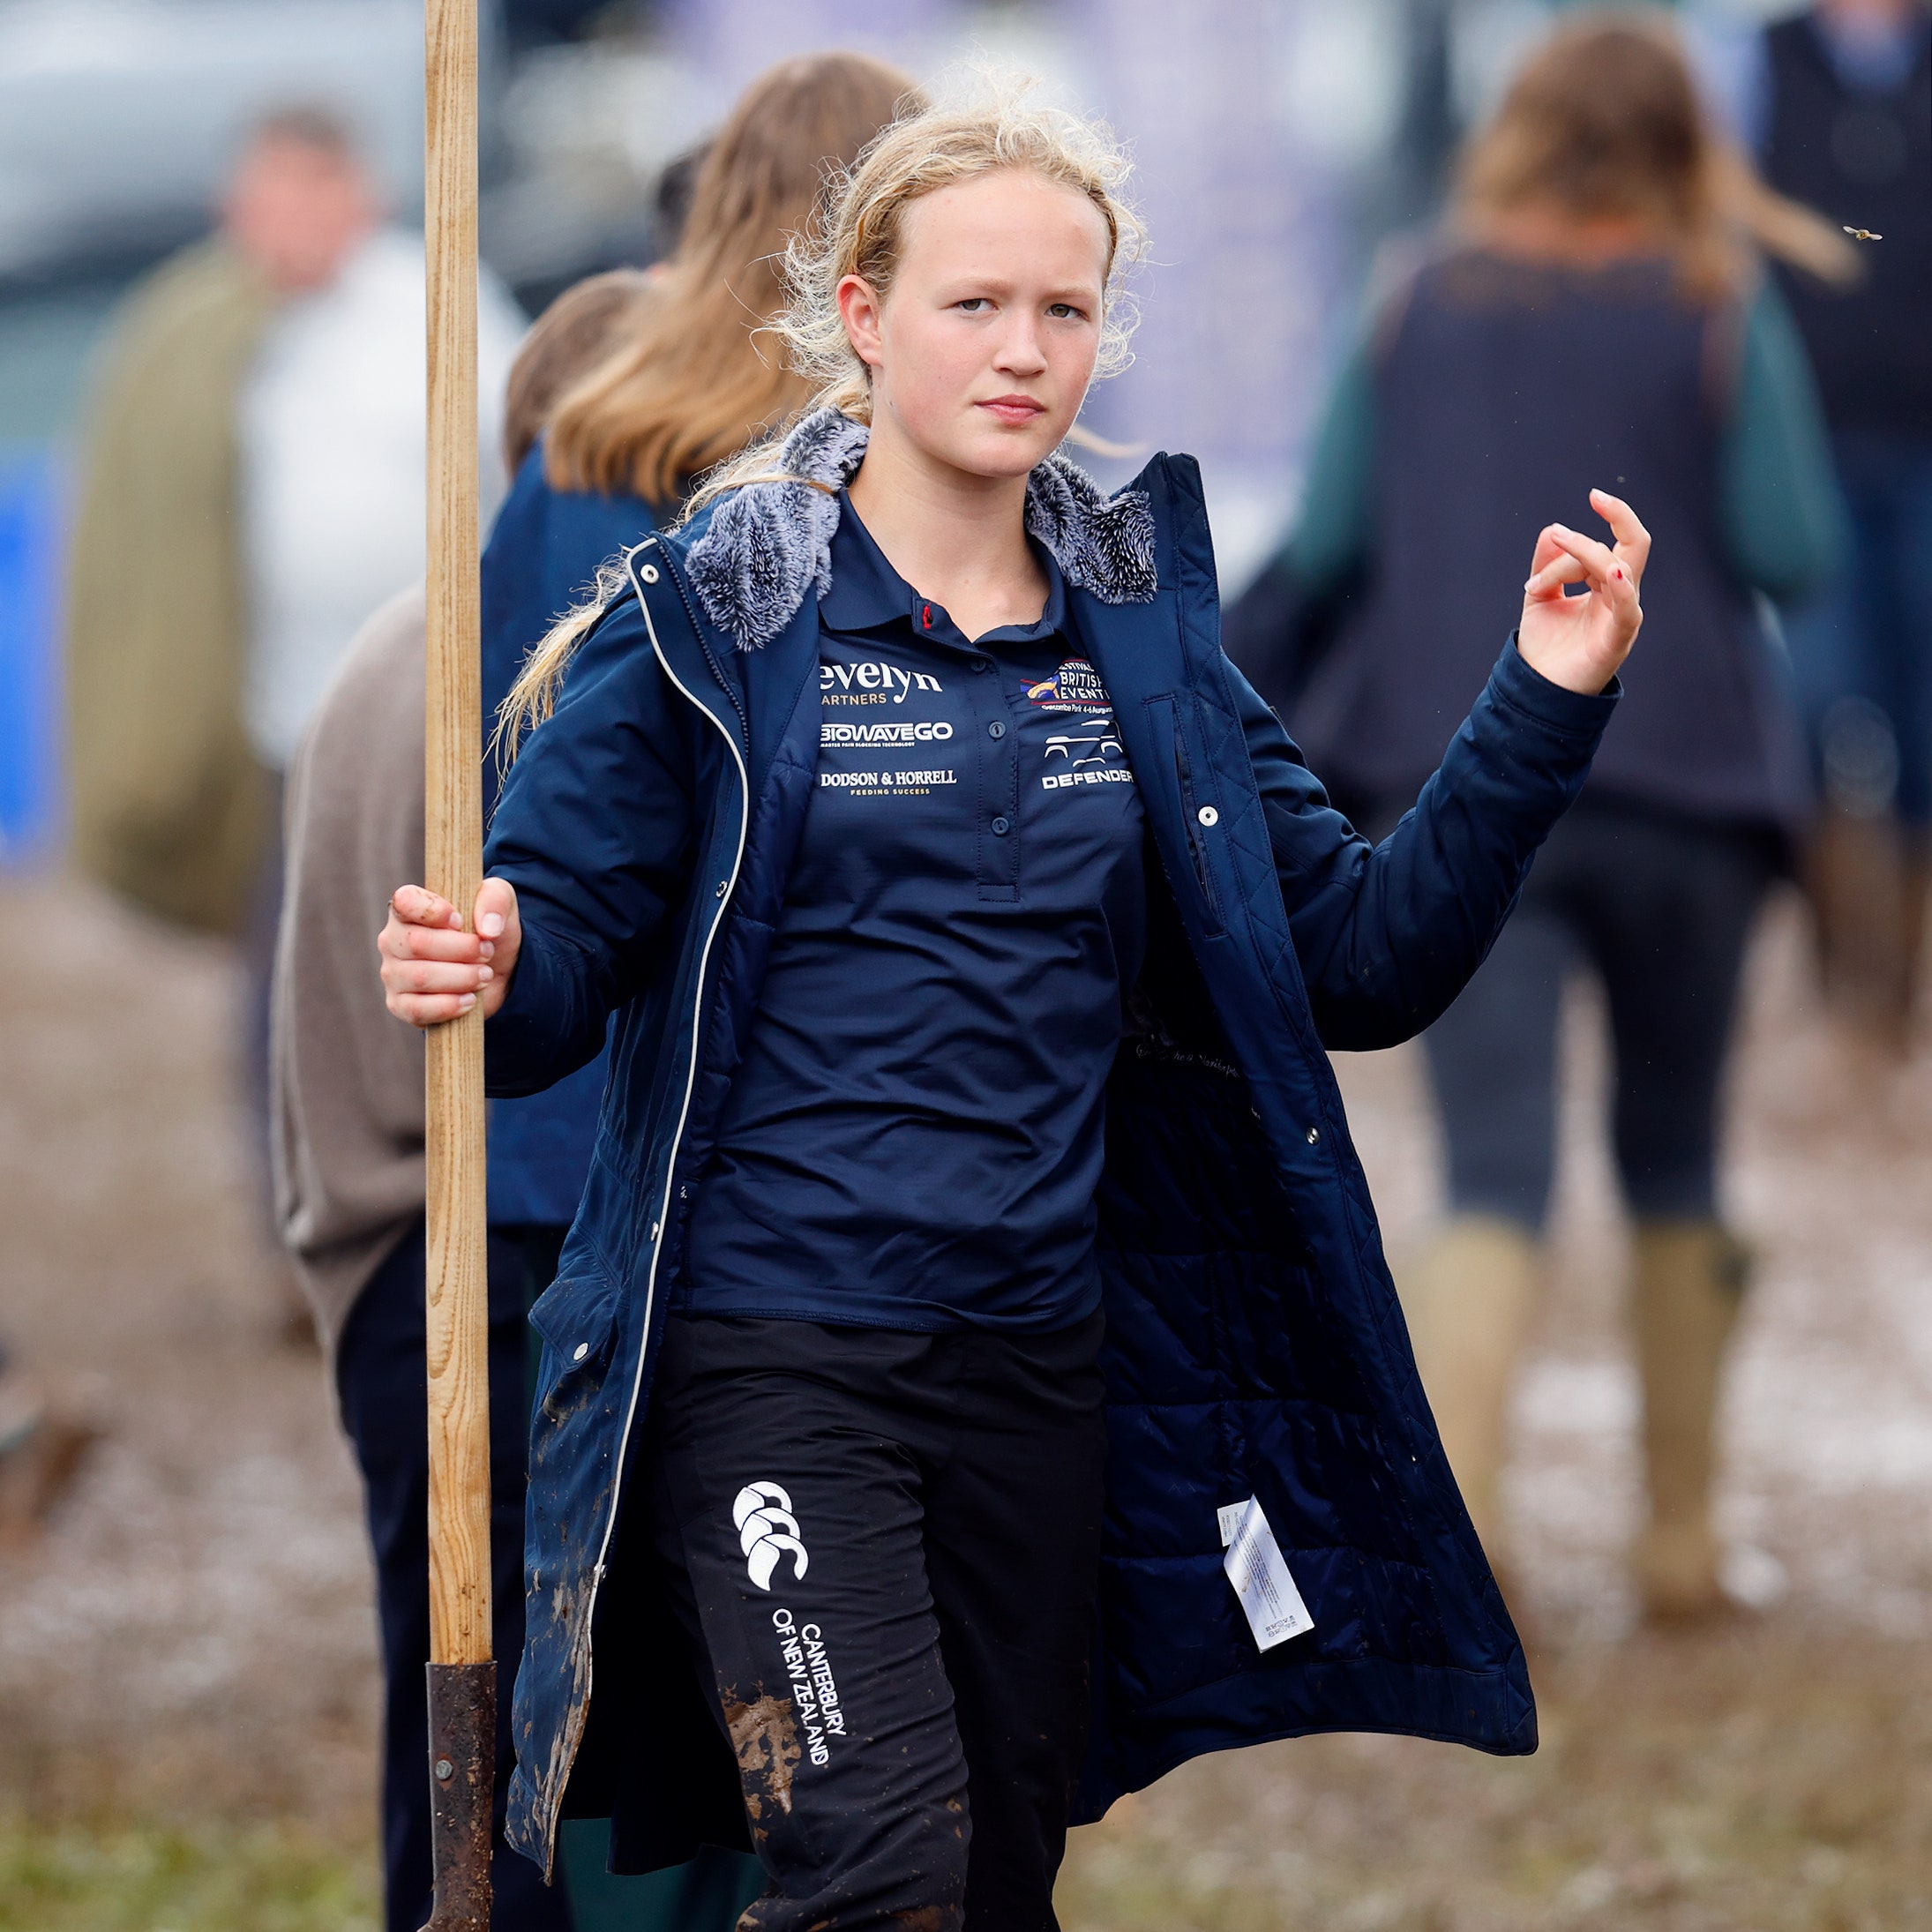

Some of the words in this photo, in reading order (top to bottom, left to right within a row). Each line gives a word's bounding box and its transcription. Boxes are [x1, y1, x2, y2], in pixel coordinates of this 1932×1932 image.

[820, 662, 943, 704] evelyn
[820, 693, 887, 706] ARTNERS
[820, 773, 878, 787] DODSON
[881, 772, 894, 786] &
[895, 770, 957, 785] HORRELL
[1041, 769, 1134, 790] DEFENDER
[772, 1608, 797, 1636] OF
[780, 1636, 808, 1679] NEW
[801, 1623, 847, 1736] CANTERBURY
[793, 1680, 830, 1765] ZEALAND
